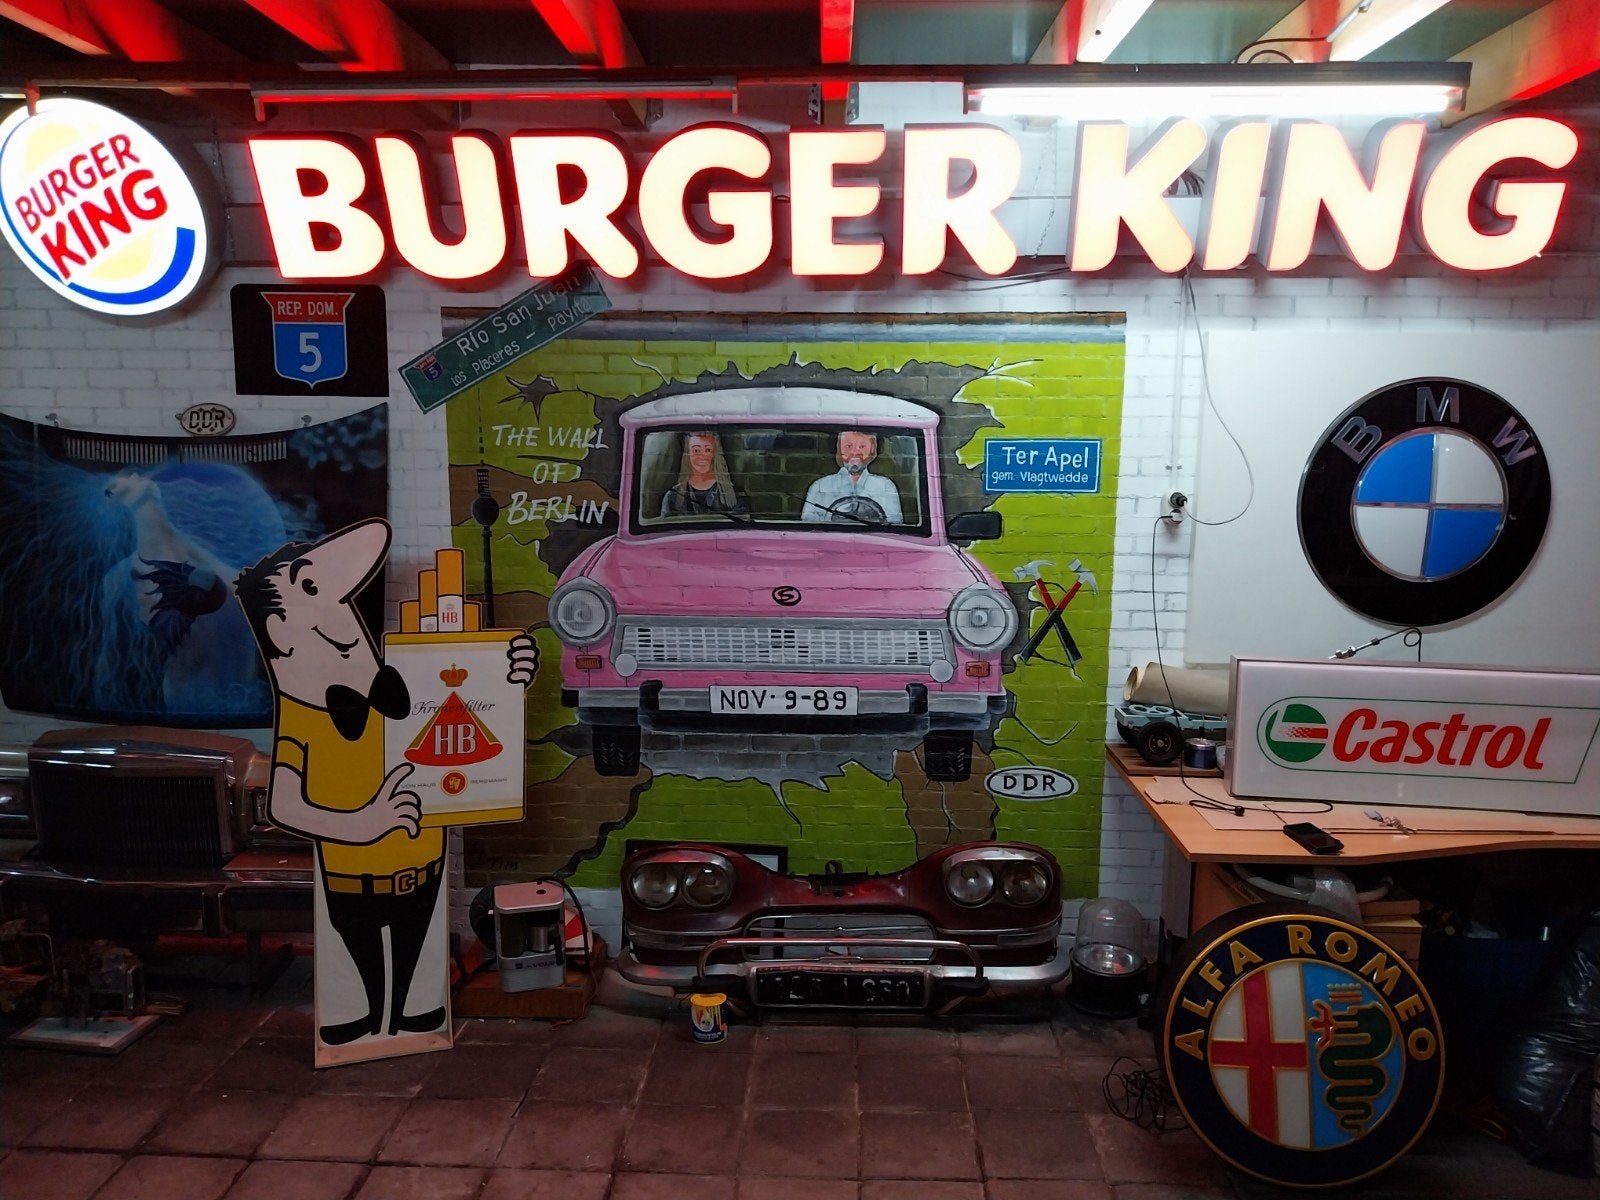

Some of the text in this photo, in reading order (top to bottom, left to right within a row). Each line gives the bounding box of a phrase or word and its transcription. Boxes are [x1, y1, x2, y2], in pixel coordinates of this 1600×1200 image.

[15, 134, 140, 234] BURGER
[249, 115, 1580, 280] BURGER KING
[40, 169, 168, 280] KING
[307, 301, 339, 317] DOM.
[492, 305, 531, 334] San
[535, 275, 580, 311] Juan
[299, 332, 322, 373] 5
[471, 341, 521, 376] Placeres
[189, 410, 227, 429] DDR
[491, 424, 609, 449] THE WALL
[1330, 386, 1537, 466] BMW
[532, 462, 570, 484] OF
[1002, 446, 1089, 472] Ter Apel
[507, 491, 610, 525] BERLIN
[441, 611, 458, 624] HB
[412, 699, 496, 717] Kronenfilter
[434, 723, 477, 756] HB
[1332, 707, 1552, 770] Castrol
[1002, 776, 1056, 792] DDR
[1175, 924, 1437, 1062] ALFA ROMEO
